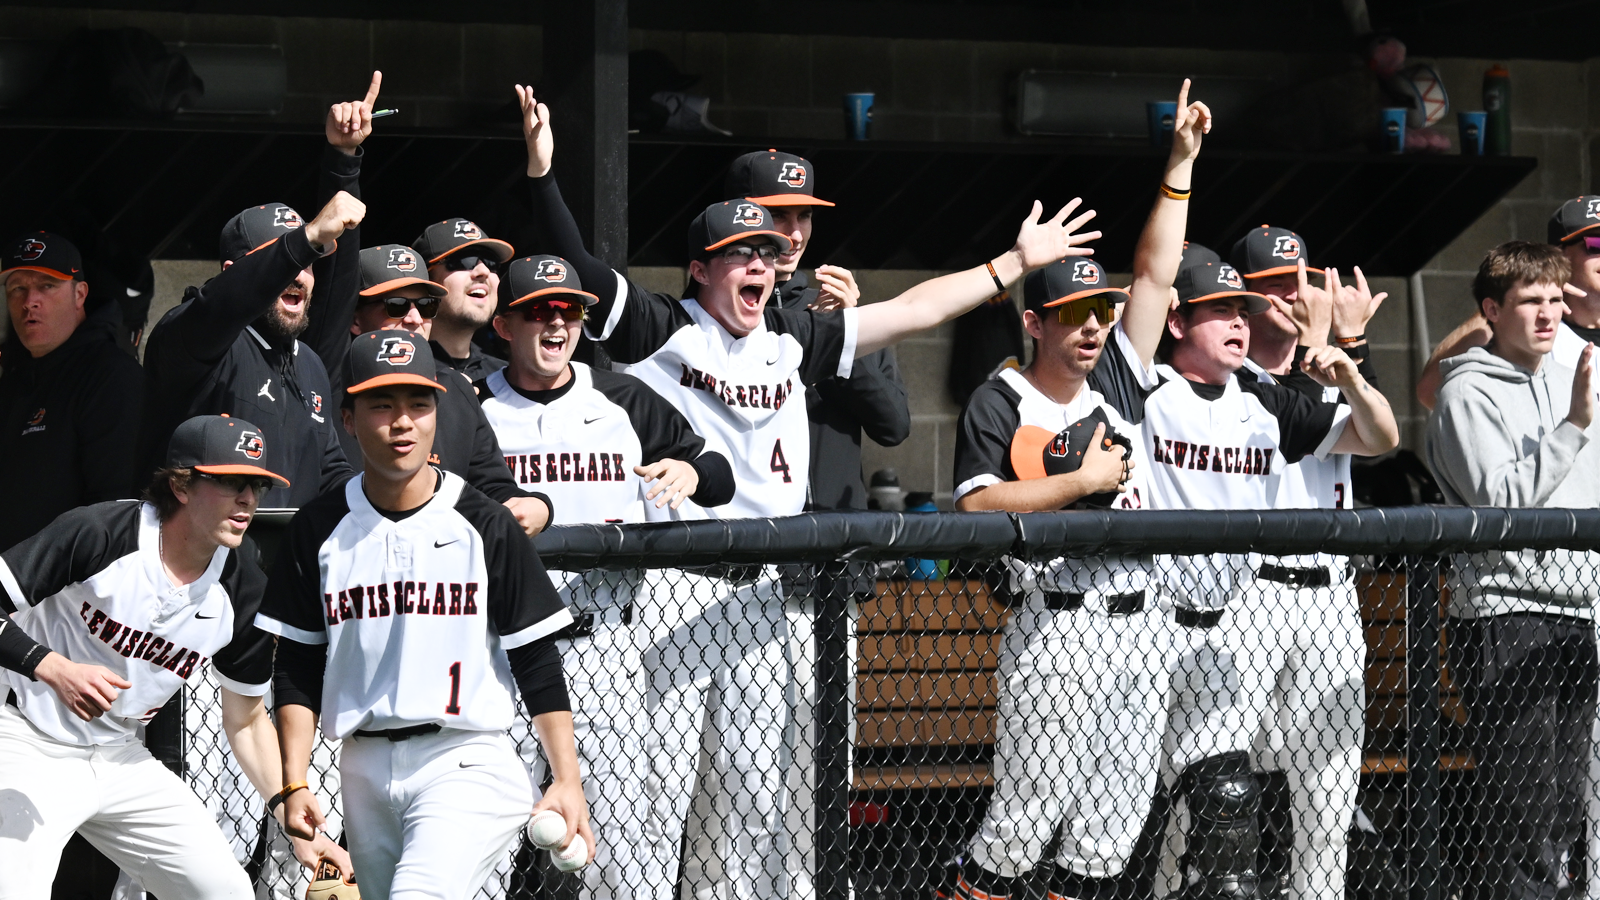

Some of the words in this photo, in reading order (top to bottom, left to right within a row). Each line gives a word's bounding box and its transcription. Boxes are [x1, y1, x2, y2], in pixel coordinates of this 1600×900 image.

[503, 452, 626, 485] WIS&CLARK
[769, 438, 793, 484] 4
[445, 661, 462, 716] 1
